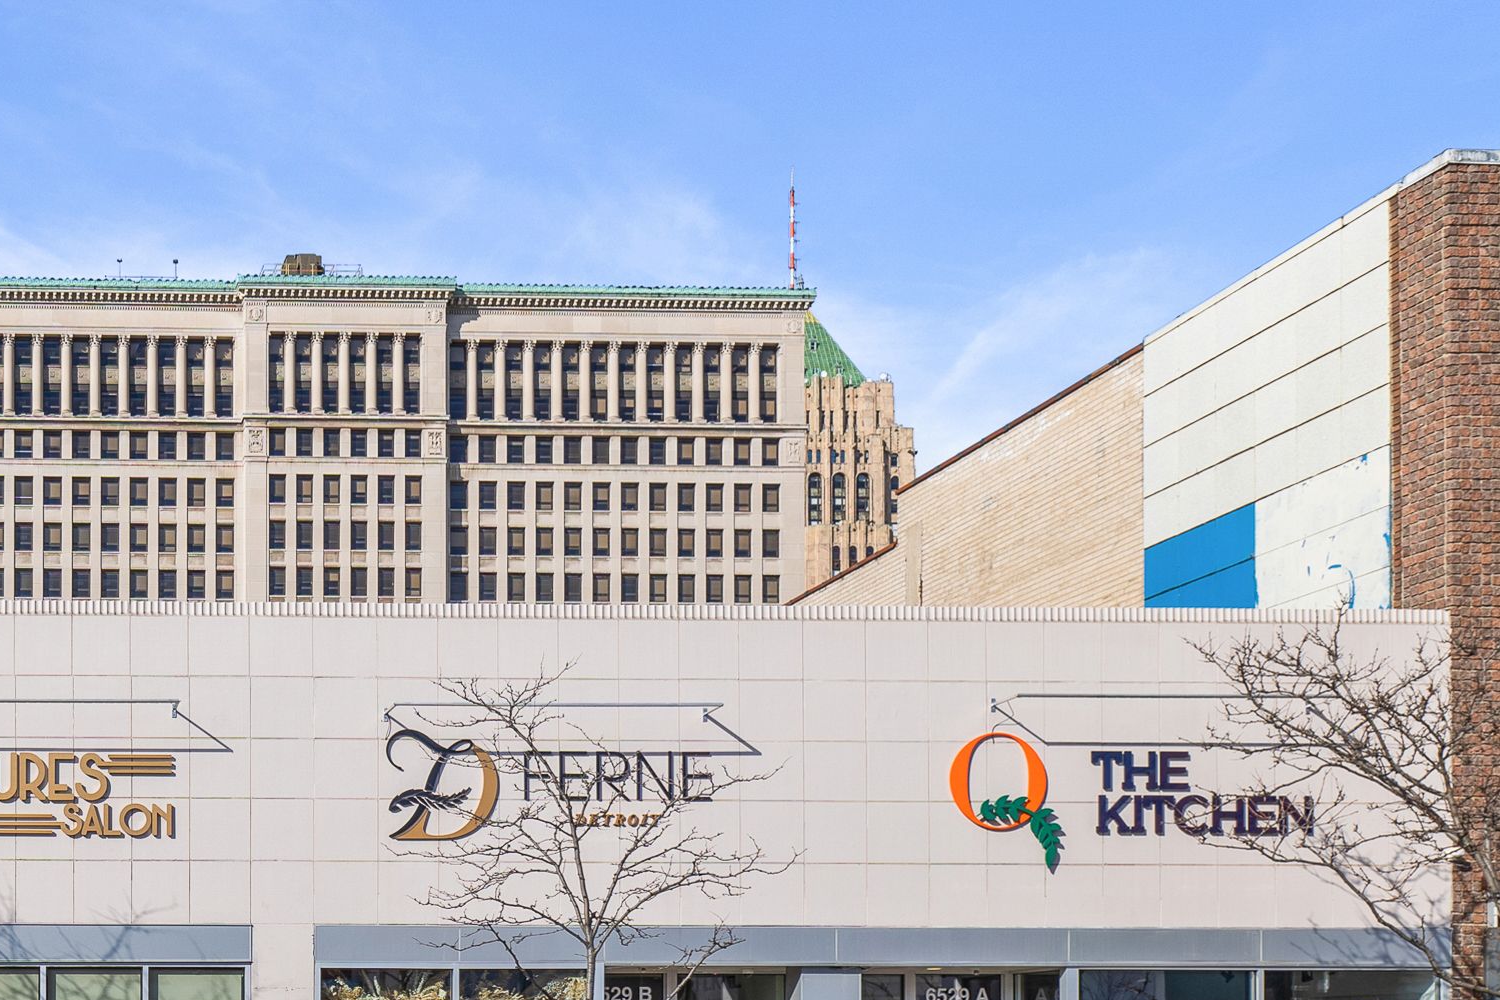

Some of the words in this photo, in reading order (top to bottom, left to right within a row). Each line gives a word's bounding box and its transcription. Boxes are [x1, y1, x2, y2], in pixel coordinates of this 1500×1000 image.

[523, 750, 714, 802] FERNE
[1091, 750, 1191, 792] THE
[59, 803, 175, 839] SALON
[1096, 795, 1315, 837] KITCHEN
